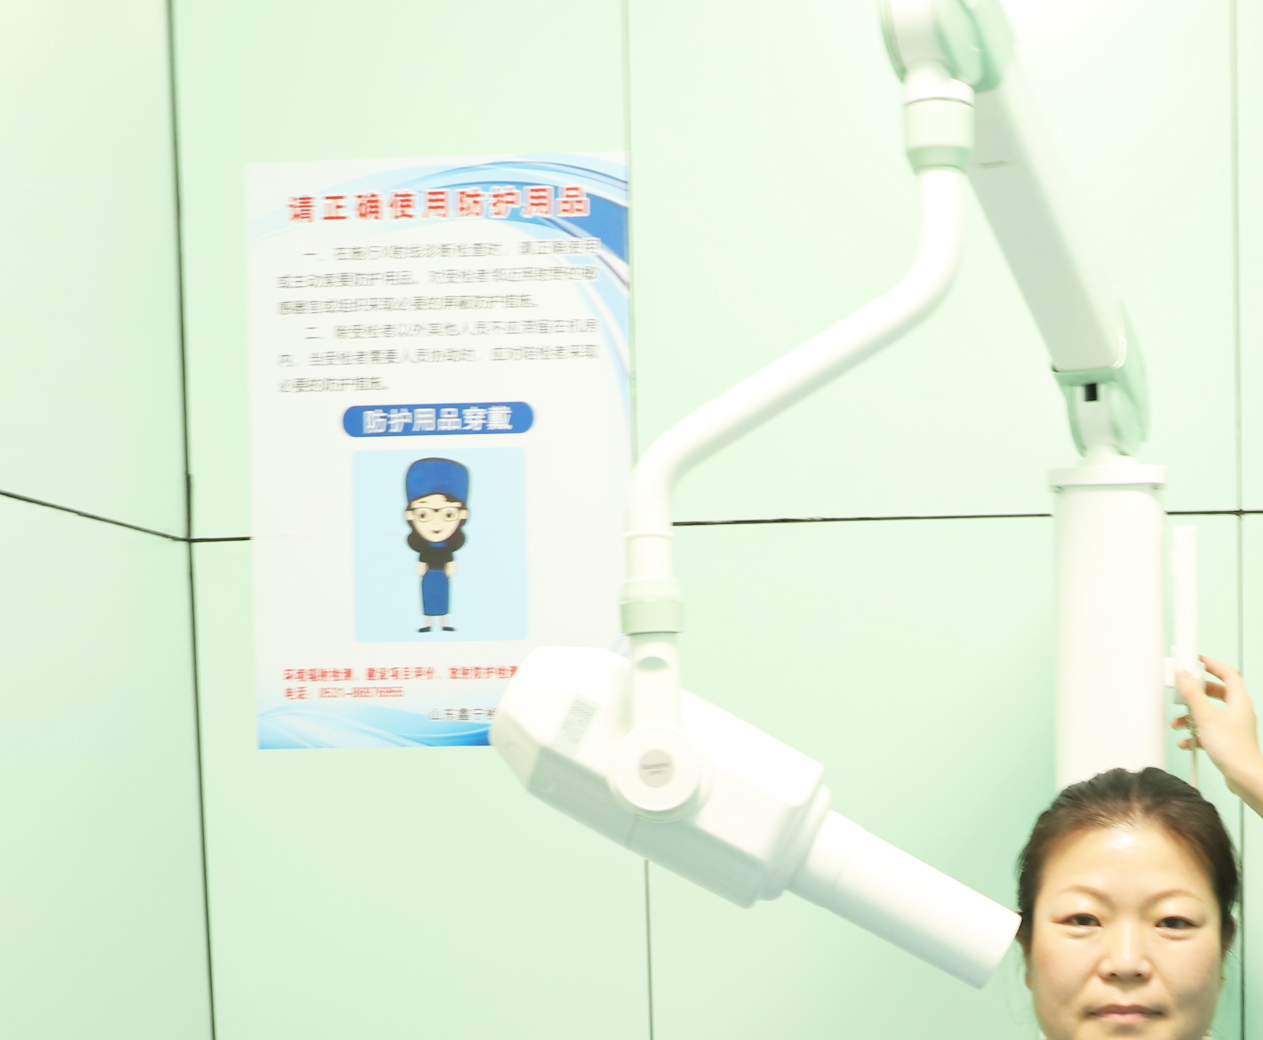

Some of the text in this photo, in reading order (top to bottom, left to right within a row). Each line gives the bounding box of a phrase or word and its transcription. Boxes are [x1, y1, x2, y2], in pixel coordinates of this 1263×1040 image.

[288, 186, 591, 222] 请正确使用防护用品
[362, 406, 513, 434] 防护用品穿戴
